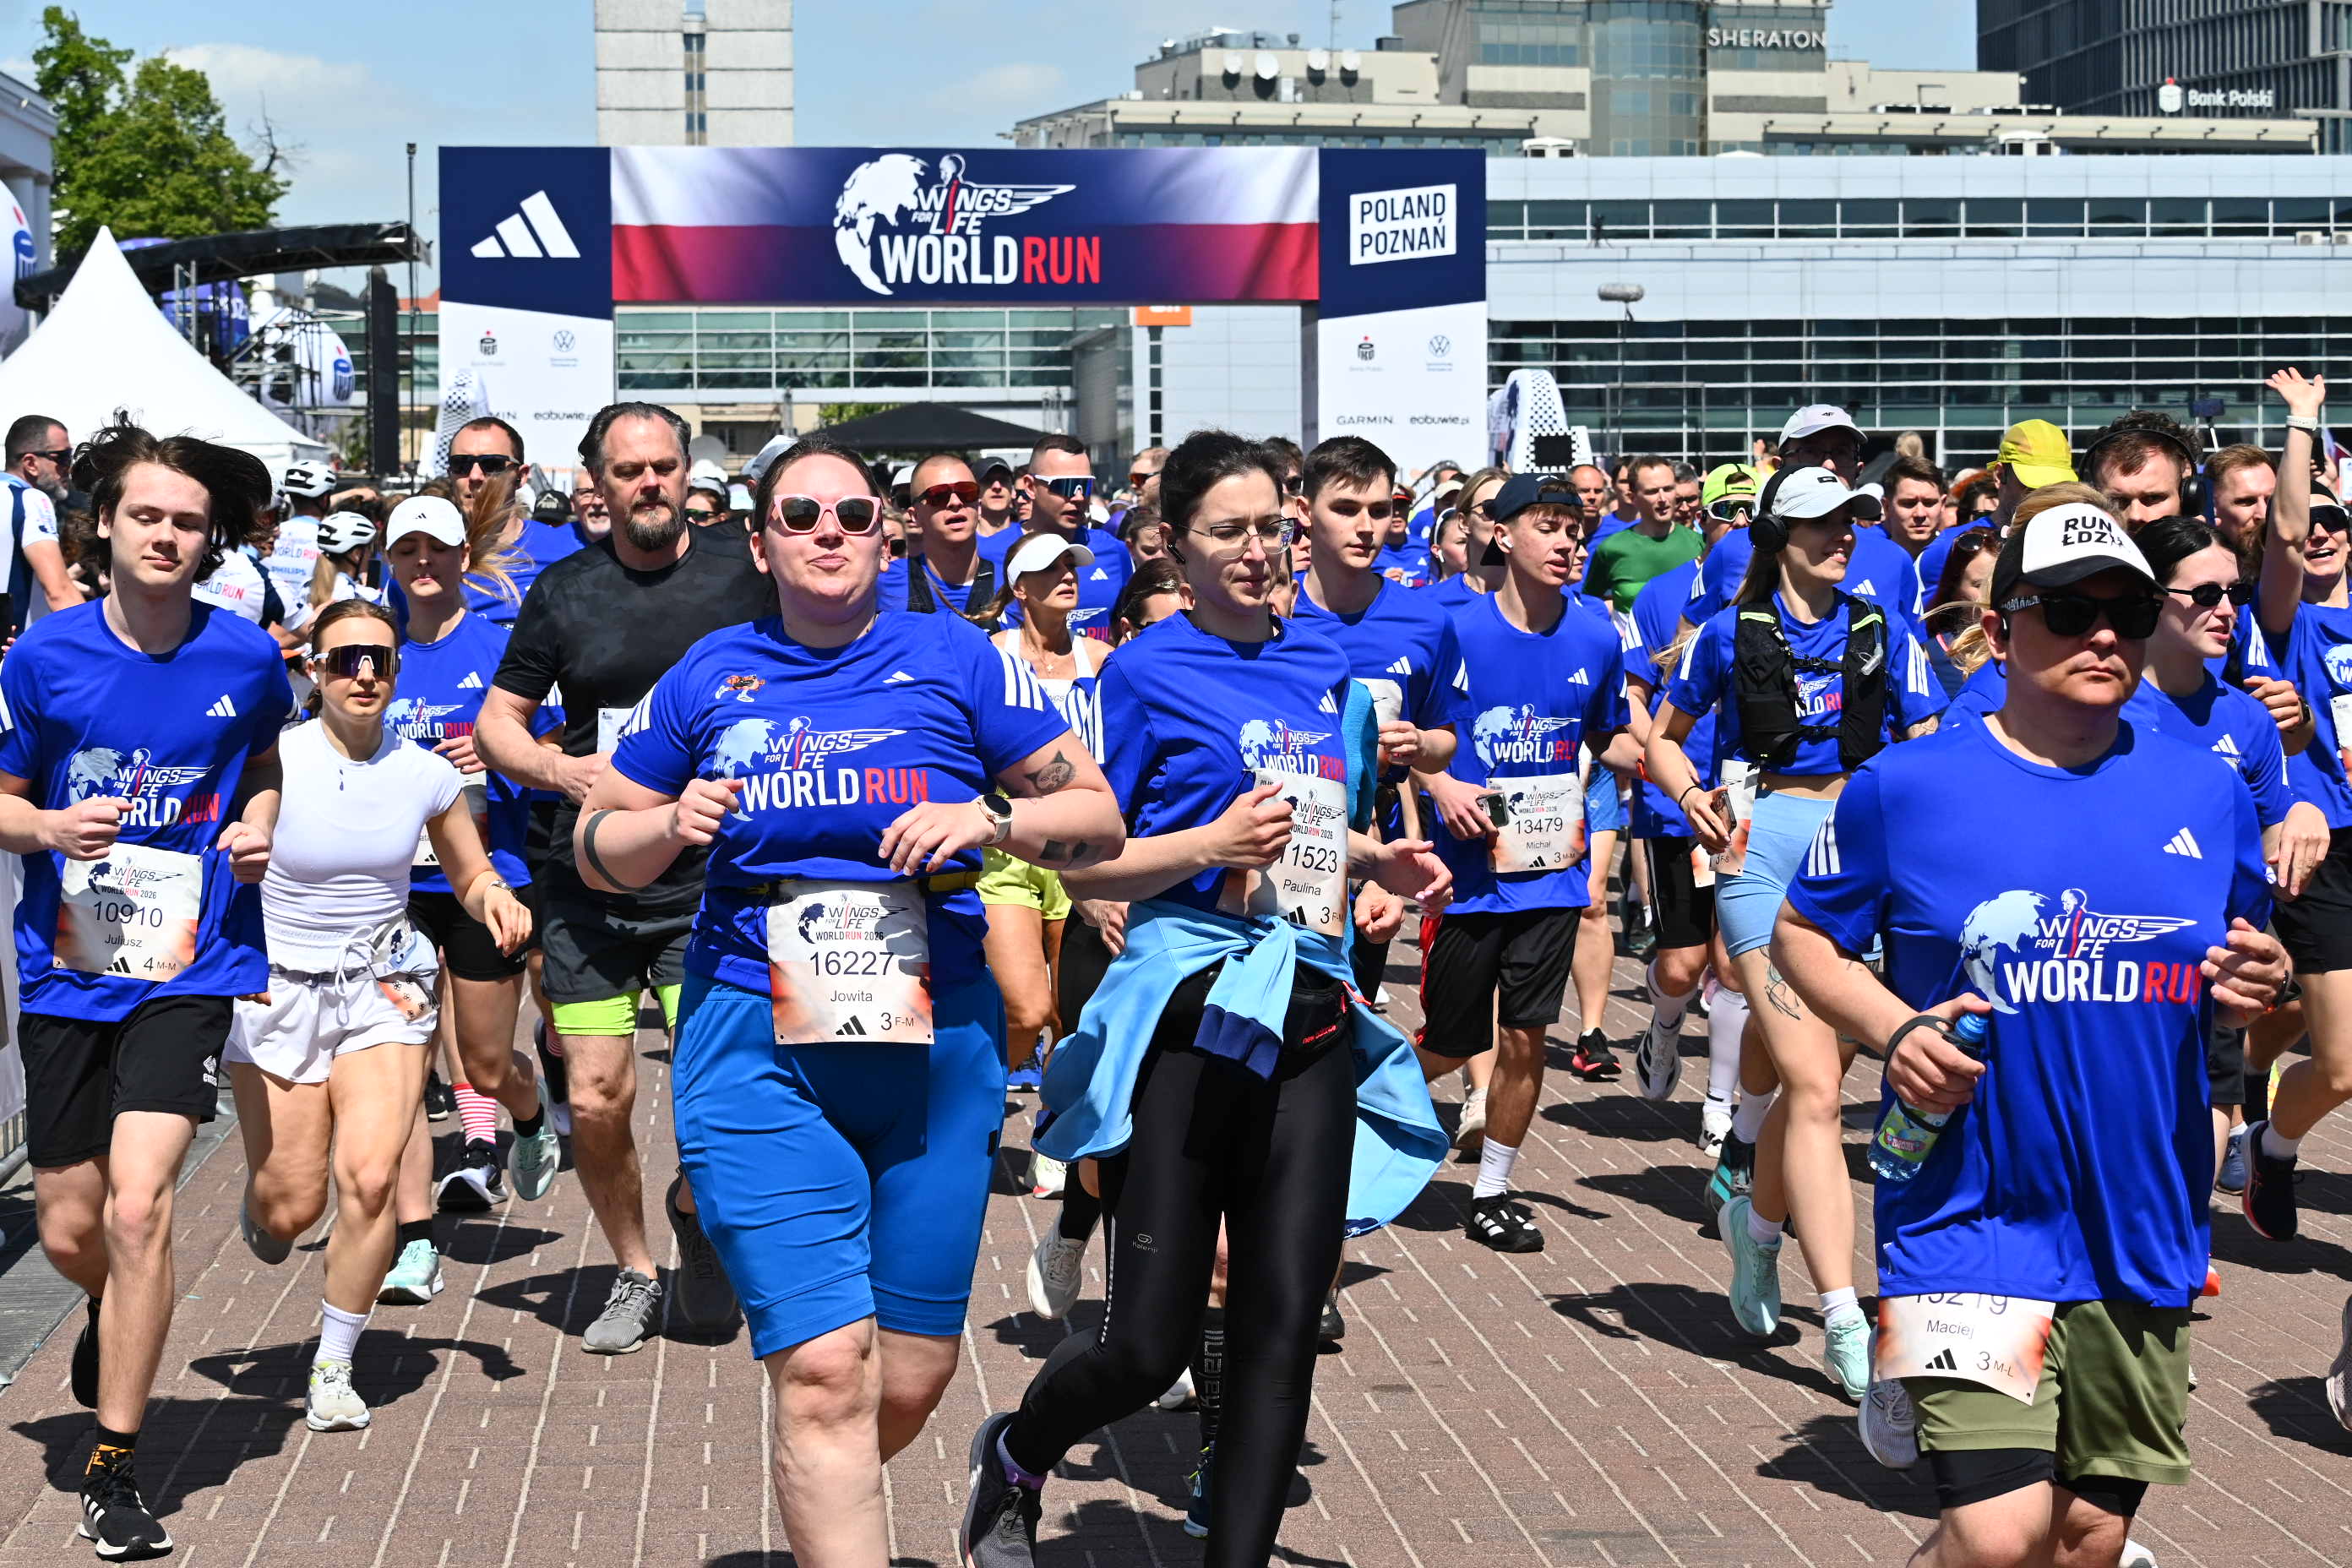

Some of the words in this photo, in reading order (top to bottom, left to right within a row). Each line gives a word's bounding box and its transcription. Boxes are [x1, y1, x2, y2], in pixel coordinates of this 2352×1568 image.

[1708, 28, 1827, 47] SHERATON
[2188, 88, 2226, 106] Bank
[2229, 88, 2273, 107] Polski
[917, 187, 1014, 212] WINGS
[1361, 193, 1446, 224] POLAND
[912, 212, 933, 223] FOR
[929, 212, 986, 235] LIFE
[1361, 217, 1446, 257] POZNAŃ
[879, 235, 1018, 284] WORLD
[1023, 237, 1100, 284] RUN
[1337, 415, 1393, 425] GARMIN
[1409, 415, 1470, 426] eobuwie.pl
[2064, 516, 2112, 532] RUN
[222, 584, 244, 601] RUN
[409, 706, 440, 716] WINGS
[397, 722, 444, 739] WORLD
[445, 721, 473, 738] RUN
[1271, 732, 1311, 743] WINGS
[1517, 731, 1544, 742] LIFE
[769, 732, 853, 754] WINGS
[1280, 743, 1303, 754] LIFE
[1494, 741, 1554, 763] WORLD
[1555, 740, 1576, 761] RU
[765, 754, 781, 764] FOR
[780, 751, 829, 770] LIFE
[1263, 754, 1319, 777] WORLD
[117, 768, 182, 784] WINGS
[122, 783, 163, 798] LIFE
[743, 767, 860, 812] WORLD
[864, 767, 928, 804] RUN
[179, 792, 220, 825] RUN
[1301, 803, 1332, 818] WINGS
[1302, 814, 1323, 826] LIFE
[1515, 817, 1564, 835] 13479
[1308, 825, 1320, 837] RUN
[1320, 828, 1334, 840] 2026
[1554, 852, 1561, 863] 3
[115, 866, 156, 881] WINGS
[117, 876, 143, 888] LIFE
[101, 885, 124, 896] WORLD
[124, 887, 139, 896] RUN
[140, 890, 157, 900] 2026
[1283, 879, 1321, 896] Paulina
[94, 901, 163, 928] 10910
[829, 906, 879, 918] WINGS
[1320, 906, 1331, 924] 3
[835, 918, 865, 929] LIFE
[2039, 917, 2139, 939] WINGS
[105, 934, 143, 948] Juliusz
[816, 931, 845, 941] WORLD
[845, 931, 862, 940] RUN
[864, 931, 885, 941] 2026
[2034, 939, 2054, 950] FOR
[2053, 939, 2110, 960] LIFE
[144, 956, 154, 972] 4
[156, 961, 177, 971] M-M
[809, 950, 895, 977] 16227
[2003, 960, 2139, 1004] WORLD
[830, 989, 873, 1003] Jowita
[880, 1012, 892, 1032] 3
[895, 1016, 914, 1027] F-M
[1926, 1320, 1974, 1339] Maciej
[1976, 1351, 1990, 1371] 3
[1994, 1359, 2014, 1378] M-L
